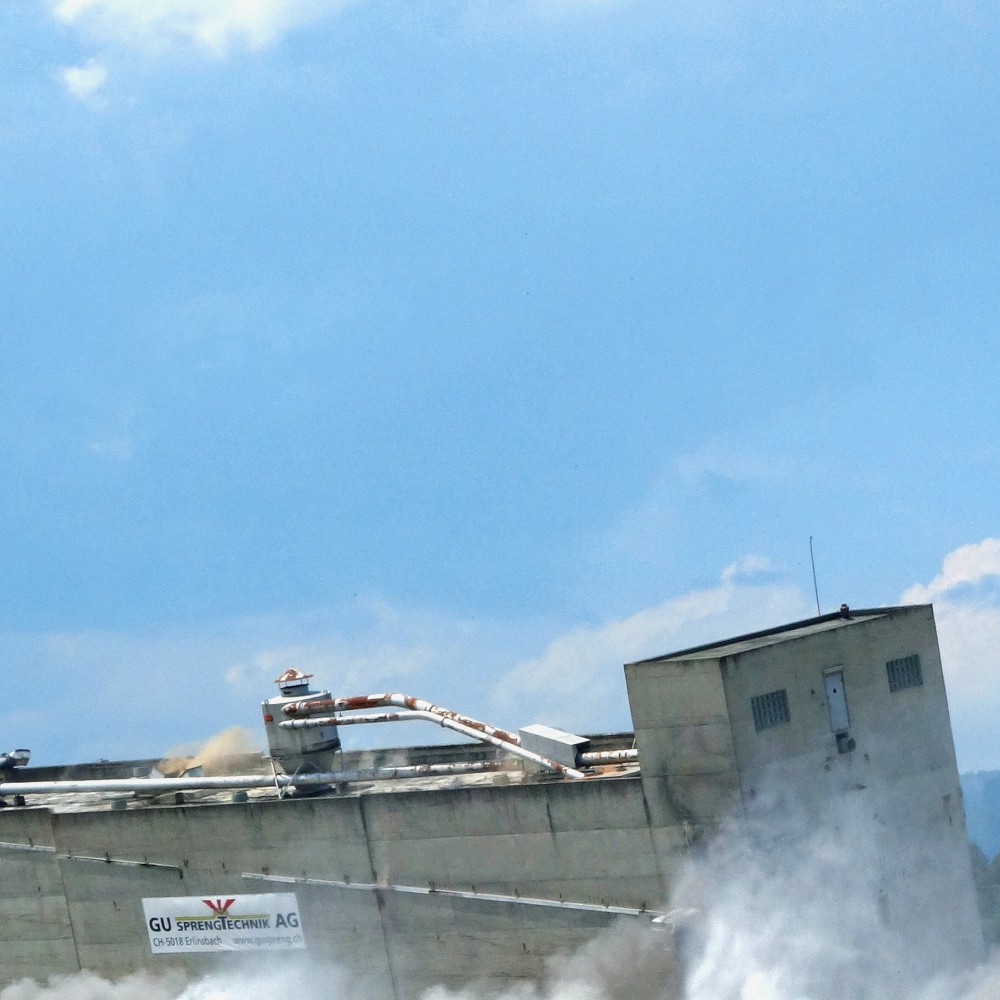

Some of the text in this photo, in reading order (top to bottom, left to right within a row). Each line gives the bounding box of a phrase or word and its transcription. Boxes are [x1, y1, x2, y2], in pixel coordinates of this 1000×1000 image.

[149, 912, 299, 932] GU SPRENGTECHNIK AG
[153, 937, 184, 947] CH-5018
